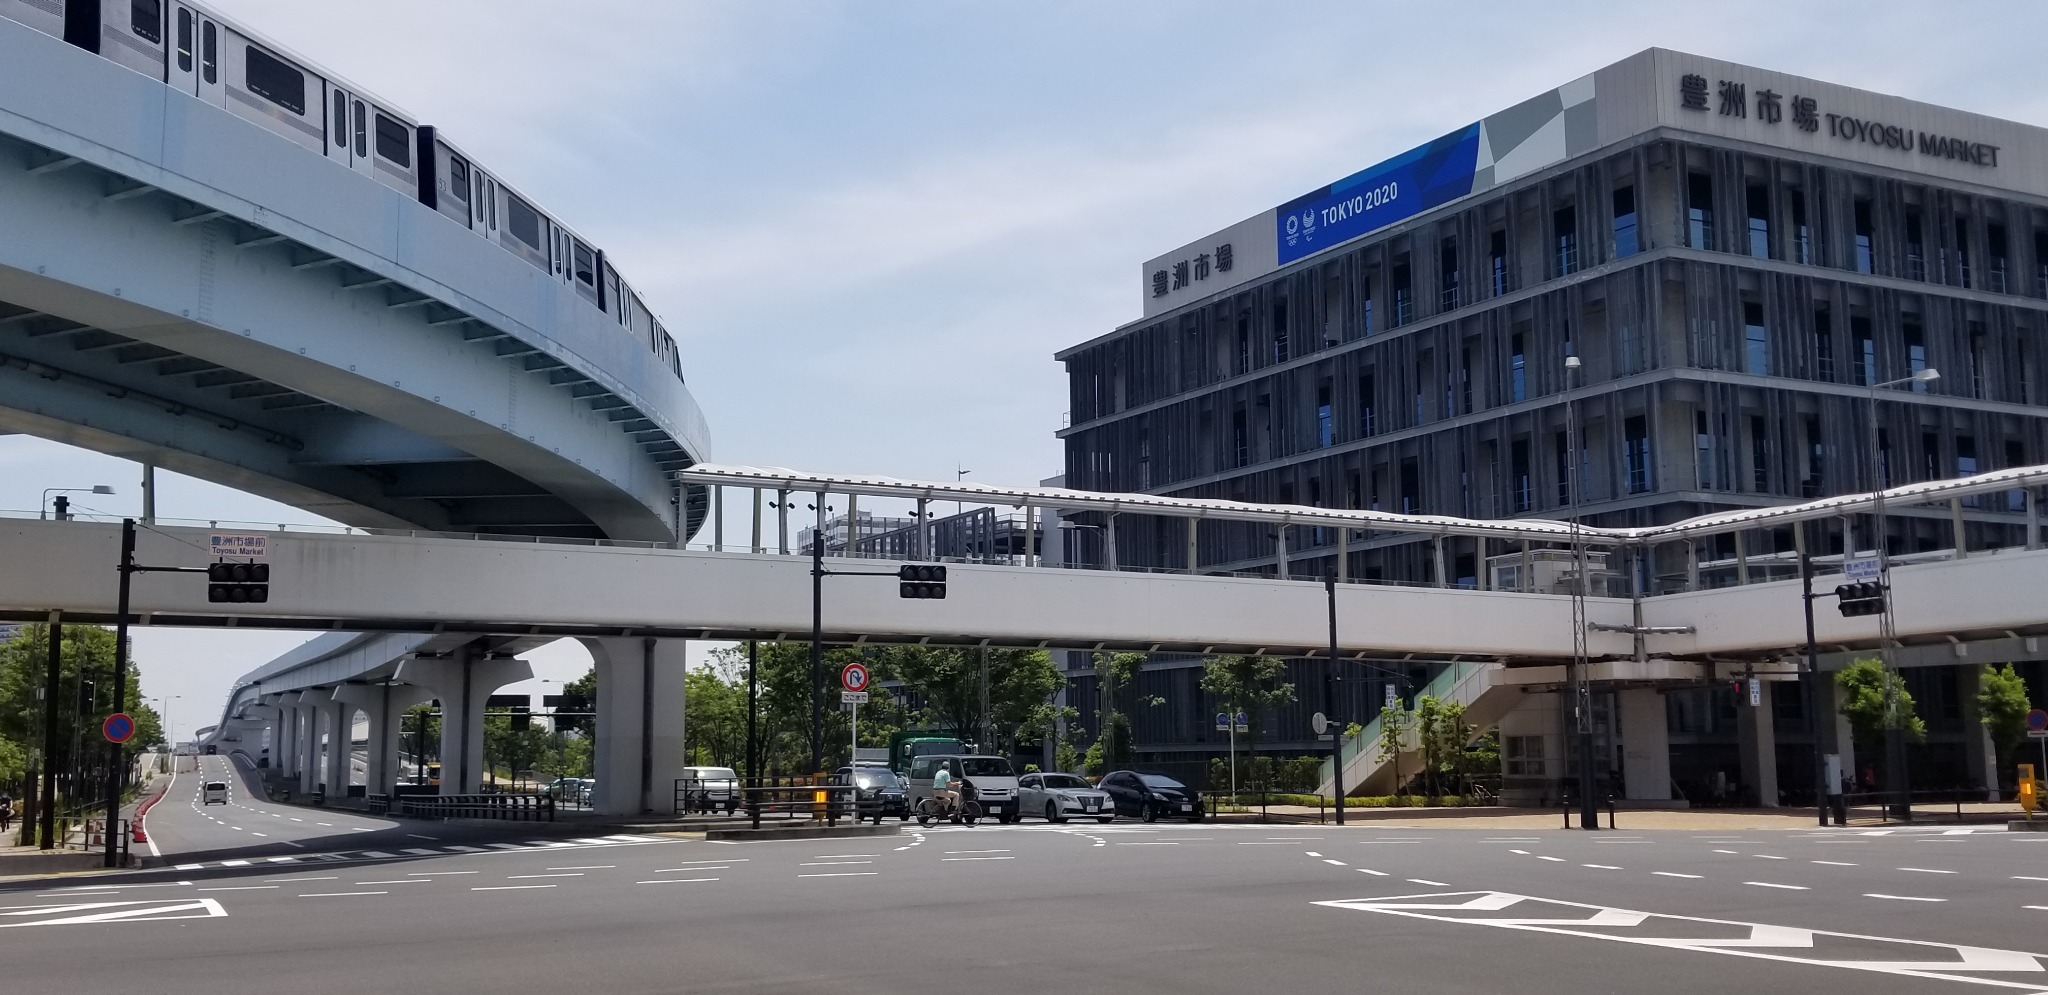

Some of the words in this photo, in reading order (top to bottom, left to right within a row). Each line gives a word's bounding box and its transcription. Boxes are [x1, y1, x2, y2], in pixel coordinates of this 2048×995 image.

[1680, 74, 1821, 132] 豊洲市場
[1825, 113, 1915, 151] TOYOSU
[1919, 132, 2001, 167] MARKET
[1321, 196, 1363, 227] TOKYO
[1365, 182, 1398, 210] 2020
[1152, 243, 1233, 298] 豊洲市場
[211, 536, 266, 547] 豊洲市場前
[212, 547, 237, 555] Toyosu
